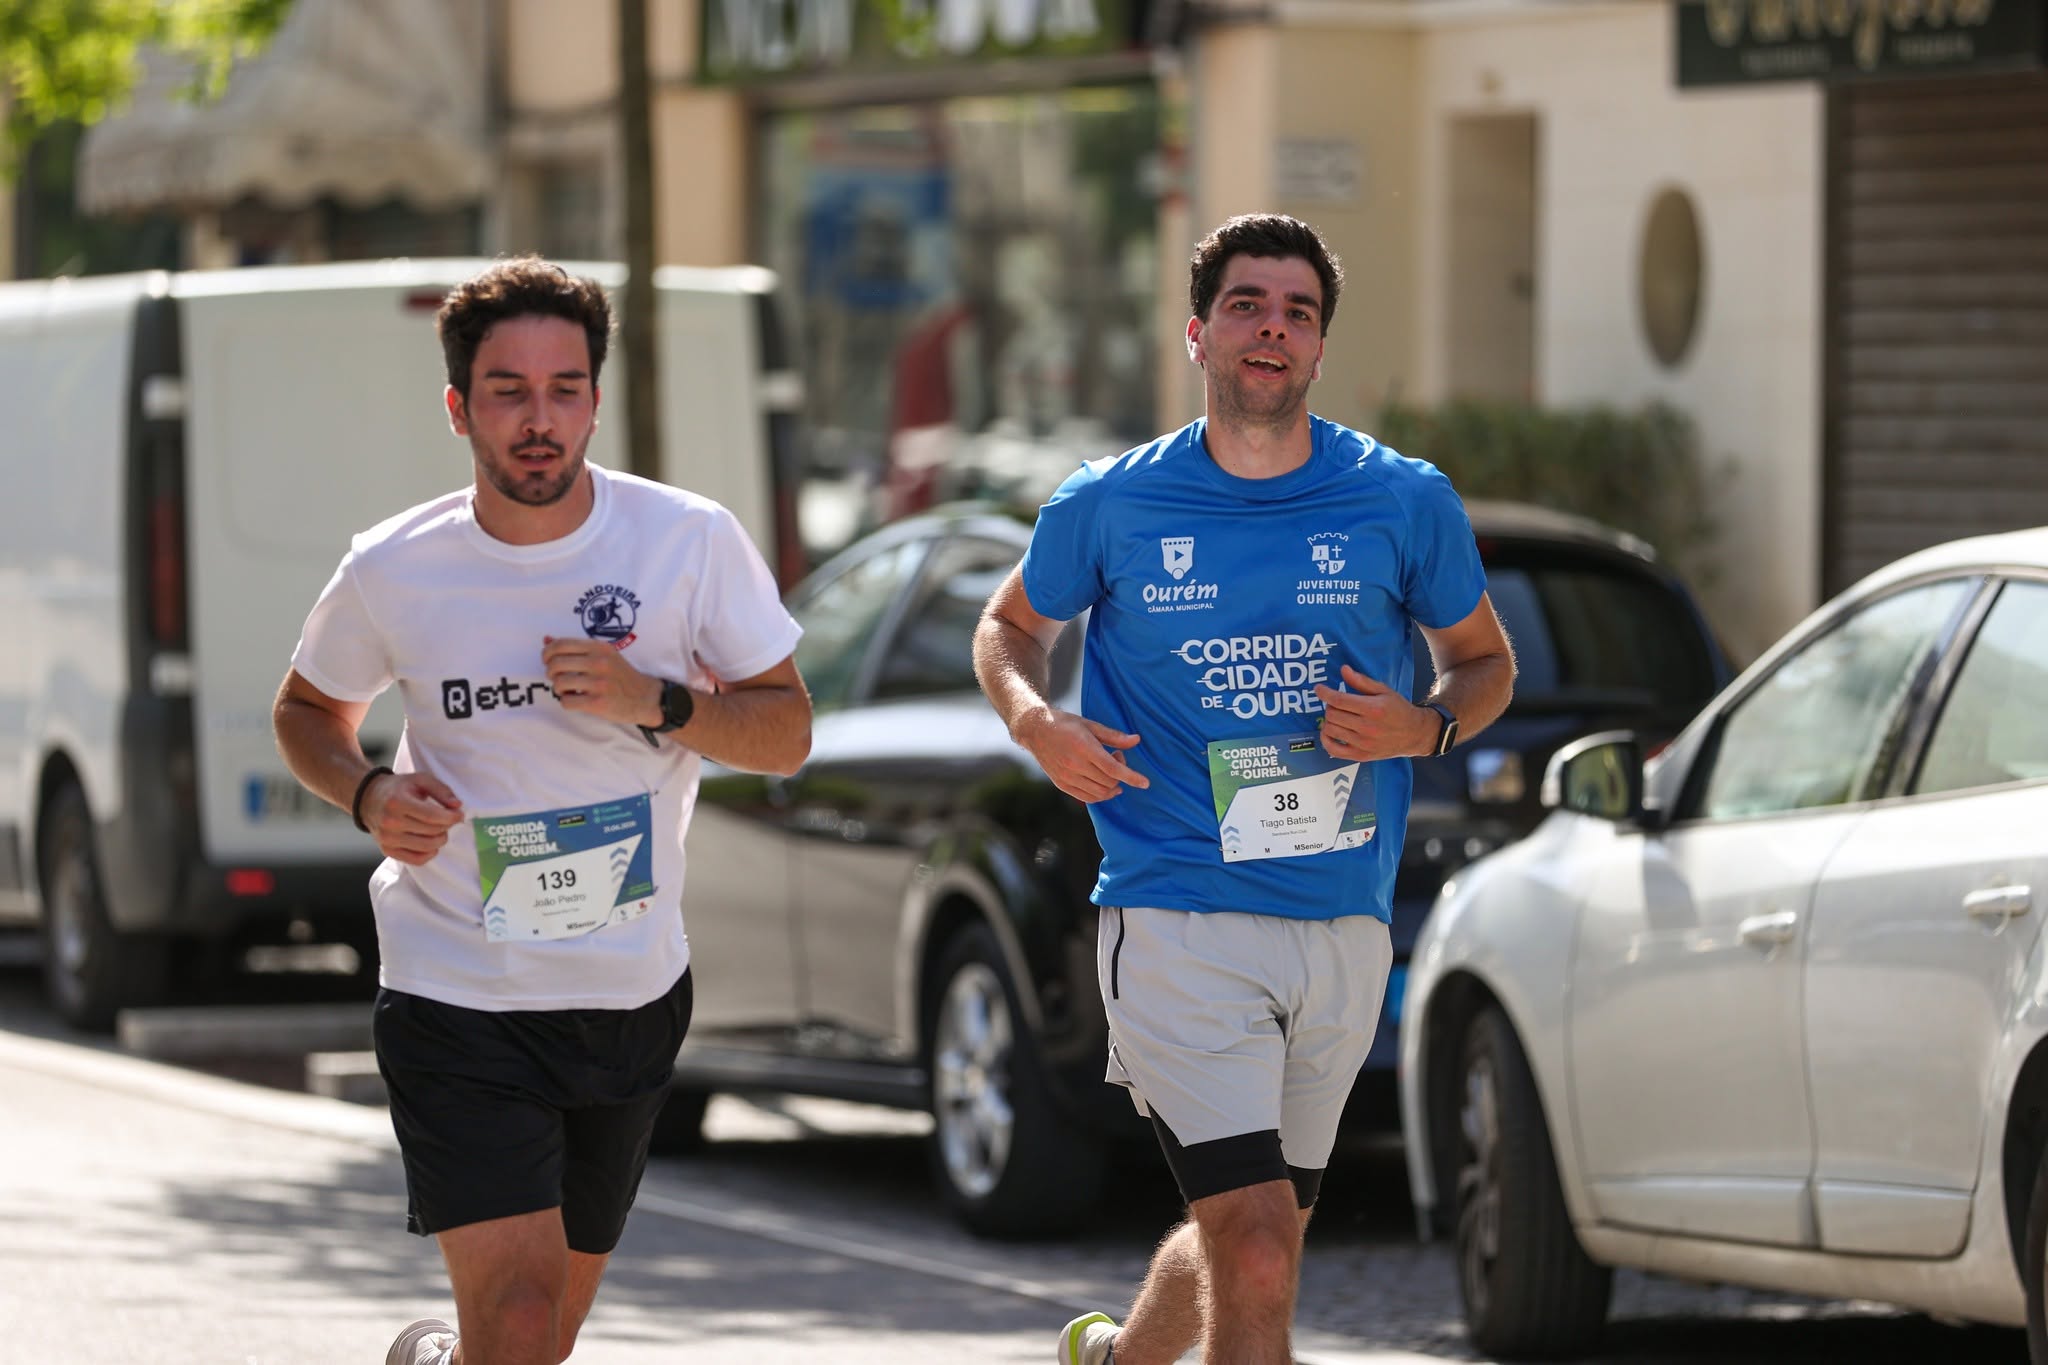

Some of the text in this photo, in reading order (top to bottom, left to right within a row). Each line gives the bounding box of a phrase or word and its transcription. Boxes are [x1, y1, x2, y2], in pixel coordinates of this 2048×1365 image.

[1142, 578, 1218, 604] Ourém
[1296, 579, 1361, 591] JUVENTUDE
[573, 584, 642, 615] SANDOEIRA
[1296, 593, 1359, 605] OURIENSE
[1147, 602, 1214, 614] CÂMARA MUNICIPAL
[1172, 633, 1337, 666] CORRIDA
[1198, 659, 1328, 692] CIDADE
[442, 676, 561, 720] Retr
[1200, 681, 1347, 720] DE OURE
[1219, 745, 1280, 760] CORRIDA
[1229, 756, 1278, 770] CIDADE
[1241, 766, 1290, 780] OUREM
[1273, 792, 1299, 812] 38
[487, 820, 548, 837] CORRIDA
[1259, 815, 1317, 829] Tiago Batista
[497, 831, 547, 847] CIDADE
[1294, 842, 1324, 851] MSenior
[510, 841, 559, 858] OUREM
[537, 869, 576, 891] 139
[533, 894, 586, 908] João Pedro
